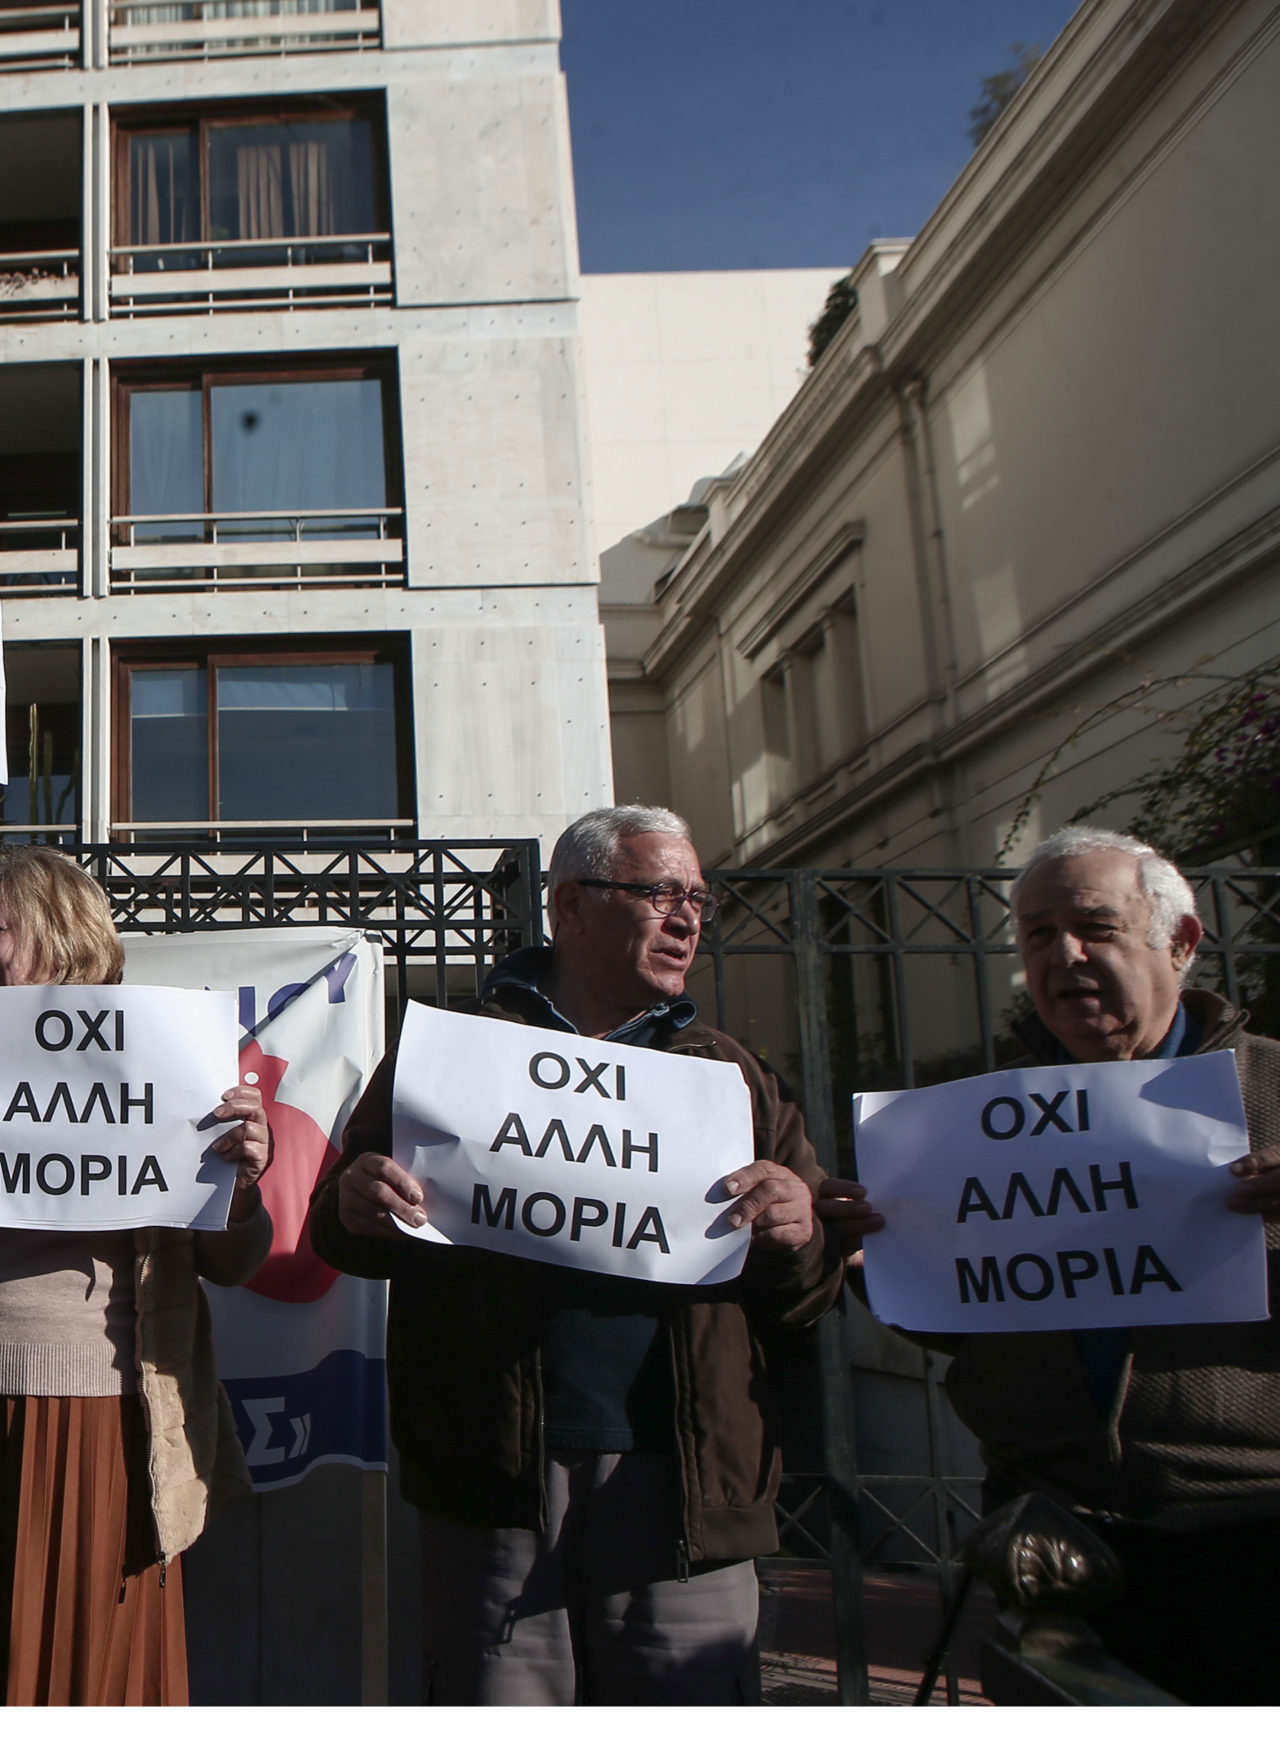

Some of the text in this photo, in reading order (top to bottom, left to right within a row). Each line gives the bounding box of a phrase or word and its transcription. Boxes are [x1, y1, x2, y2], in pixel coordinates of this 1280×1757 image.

[35, 1010, 123, 1051] ΟΧΙ
[3, 1082, 153, 1124] ΑΛΛΗ
[529, 1052, 625, 1100] ΟΧΙ
[981, 1090, 1089, 1140] ΟΧΙ
[489, 1113, 658, 1172] ΑΛΛΗ
[470, 1183, 671, 1255] ΜΟΡΙΑ
[957, 1162, 1139, 1223] ΑΛΛΗ
[955, 1245, 1183, 1303] ΜΟΡΙΑ
